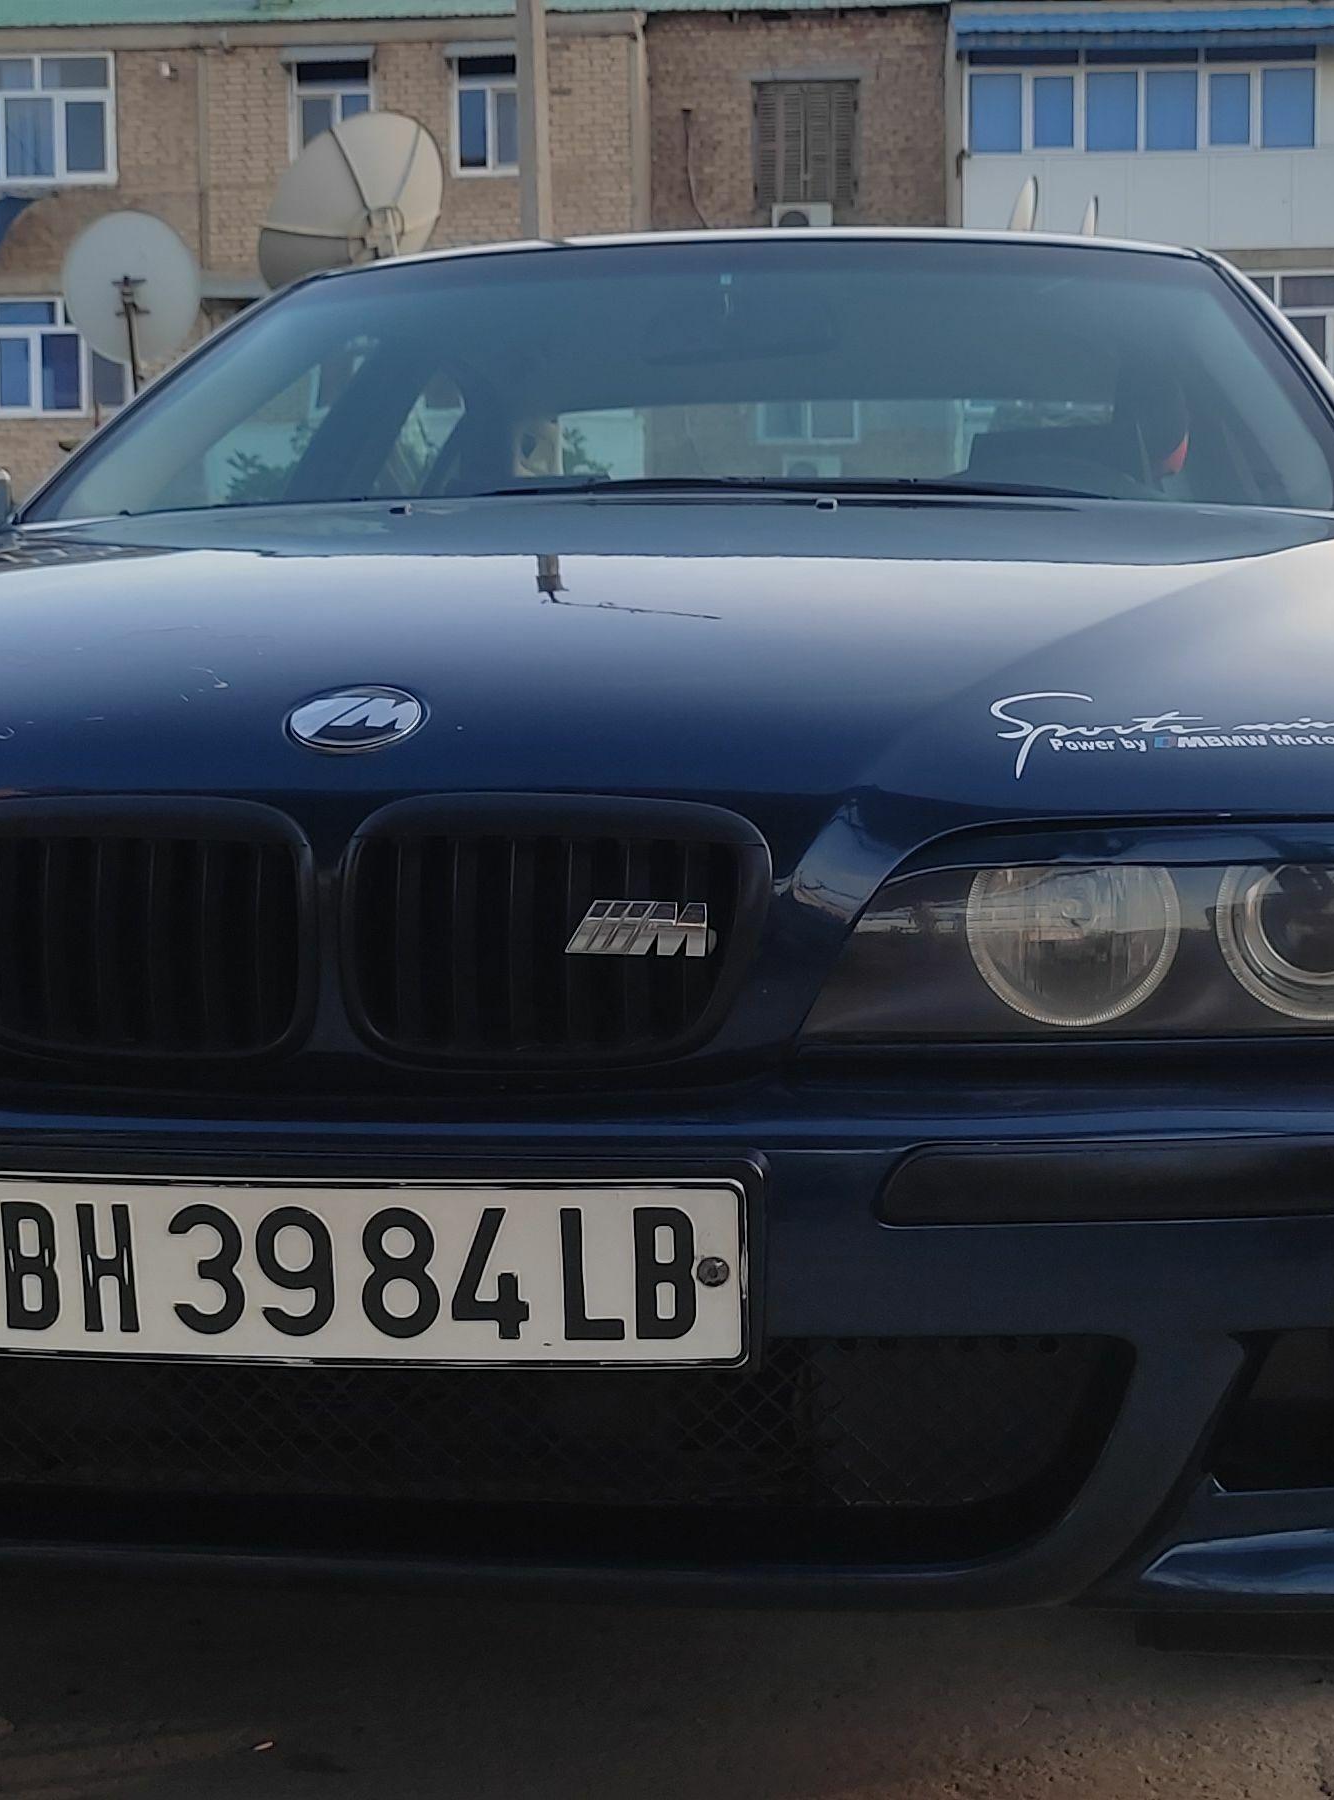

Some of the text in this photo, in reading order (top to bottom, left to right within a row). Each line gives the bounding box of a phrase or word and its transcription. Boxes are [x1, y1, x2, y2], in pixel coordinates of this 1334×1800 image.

[1049, 736, 1115, 752] Power
[1122, 736, 1148, 753] by
[0, 1201, 140, 1333] BH
[560, 1207, 697, 1340] LB
